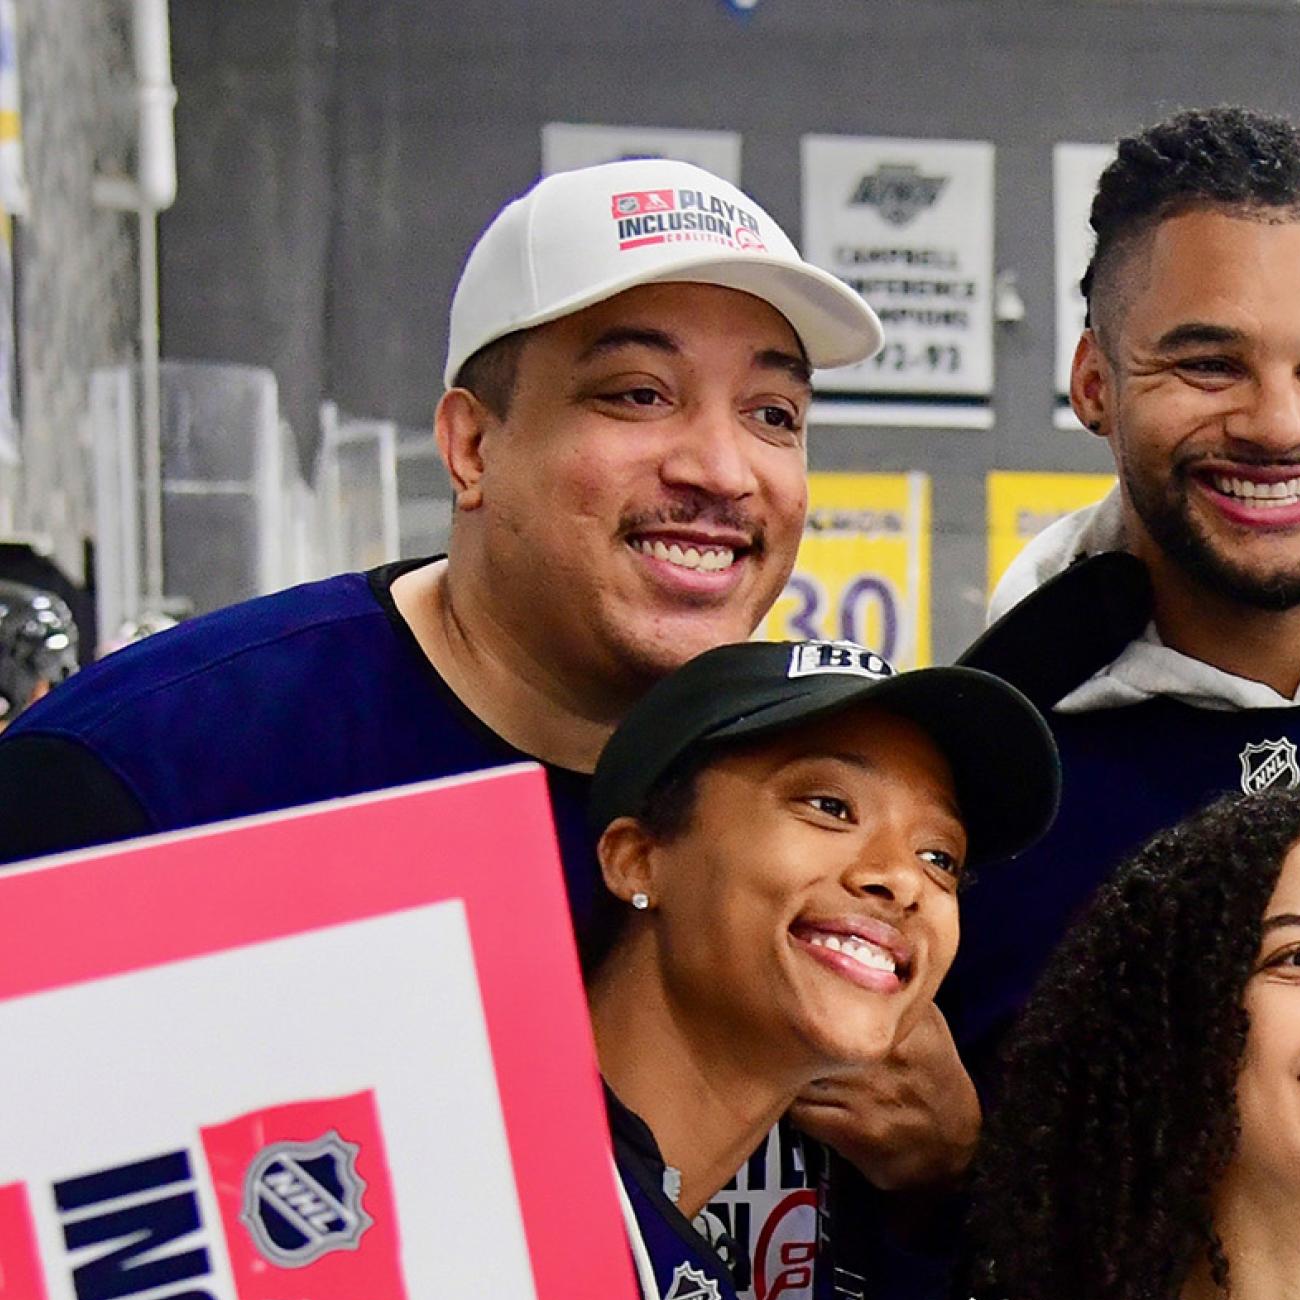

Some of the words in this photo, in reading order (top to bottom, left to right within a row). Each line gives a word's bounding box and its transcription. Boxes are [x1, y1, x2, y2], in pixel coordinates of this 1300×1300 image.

[618, 211, 733, 239] INCLUSION
[677, 189, 761, 236] PLAYER
[264, 1165, 338, 1235] NHL
